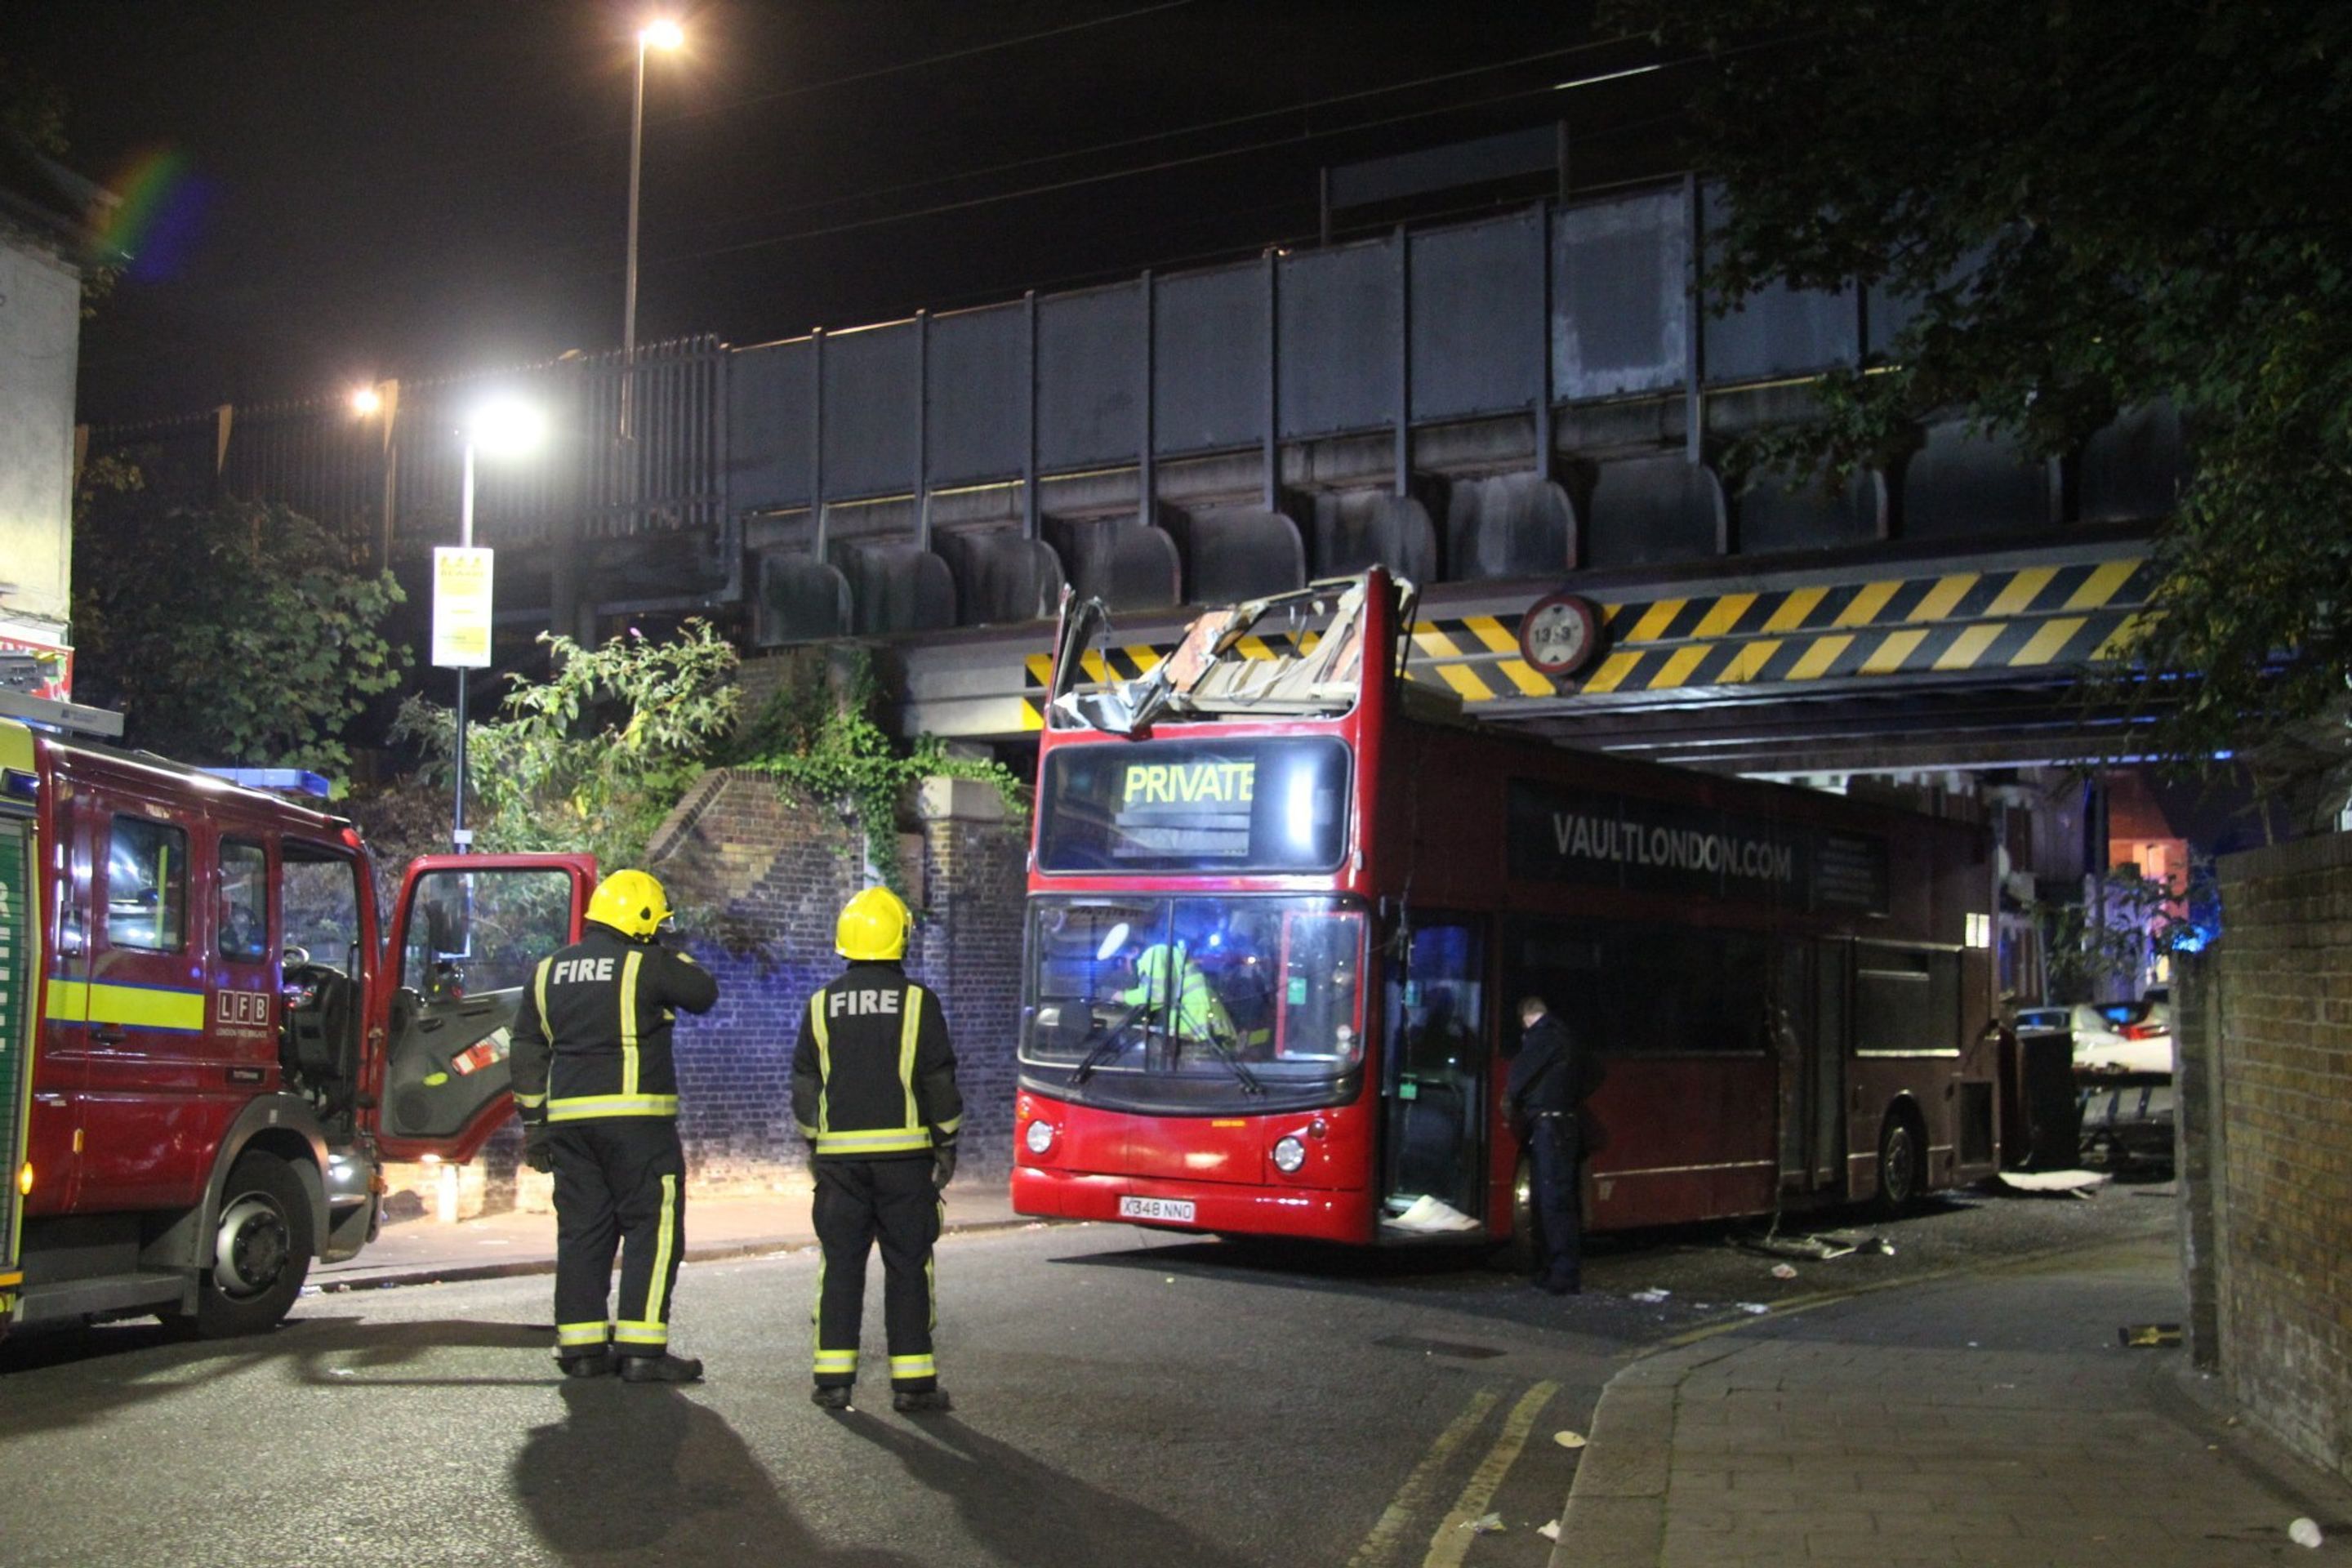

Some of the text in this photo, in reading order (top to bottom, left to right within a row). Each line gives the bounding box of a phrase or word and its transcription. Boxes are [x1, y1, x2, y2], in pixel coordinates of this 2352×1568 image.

[1124, 763, 1255, 803] PRIVATE
[1553, 813, 1792, 882] VAULTLONDON.COM
[554, 958, 614, 984] FIRE
[221, 995, 266, 1020] LFB
[831, 990, 900, 1018] FIRE
